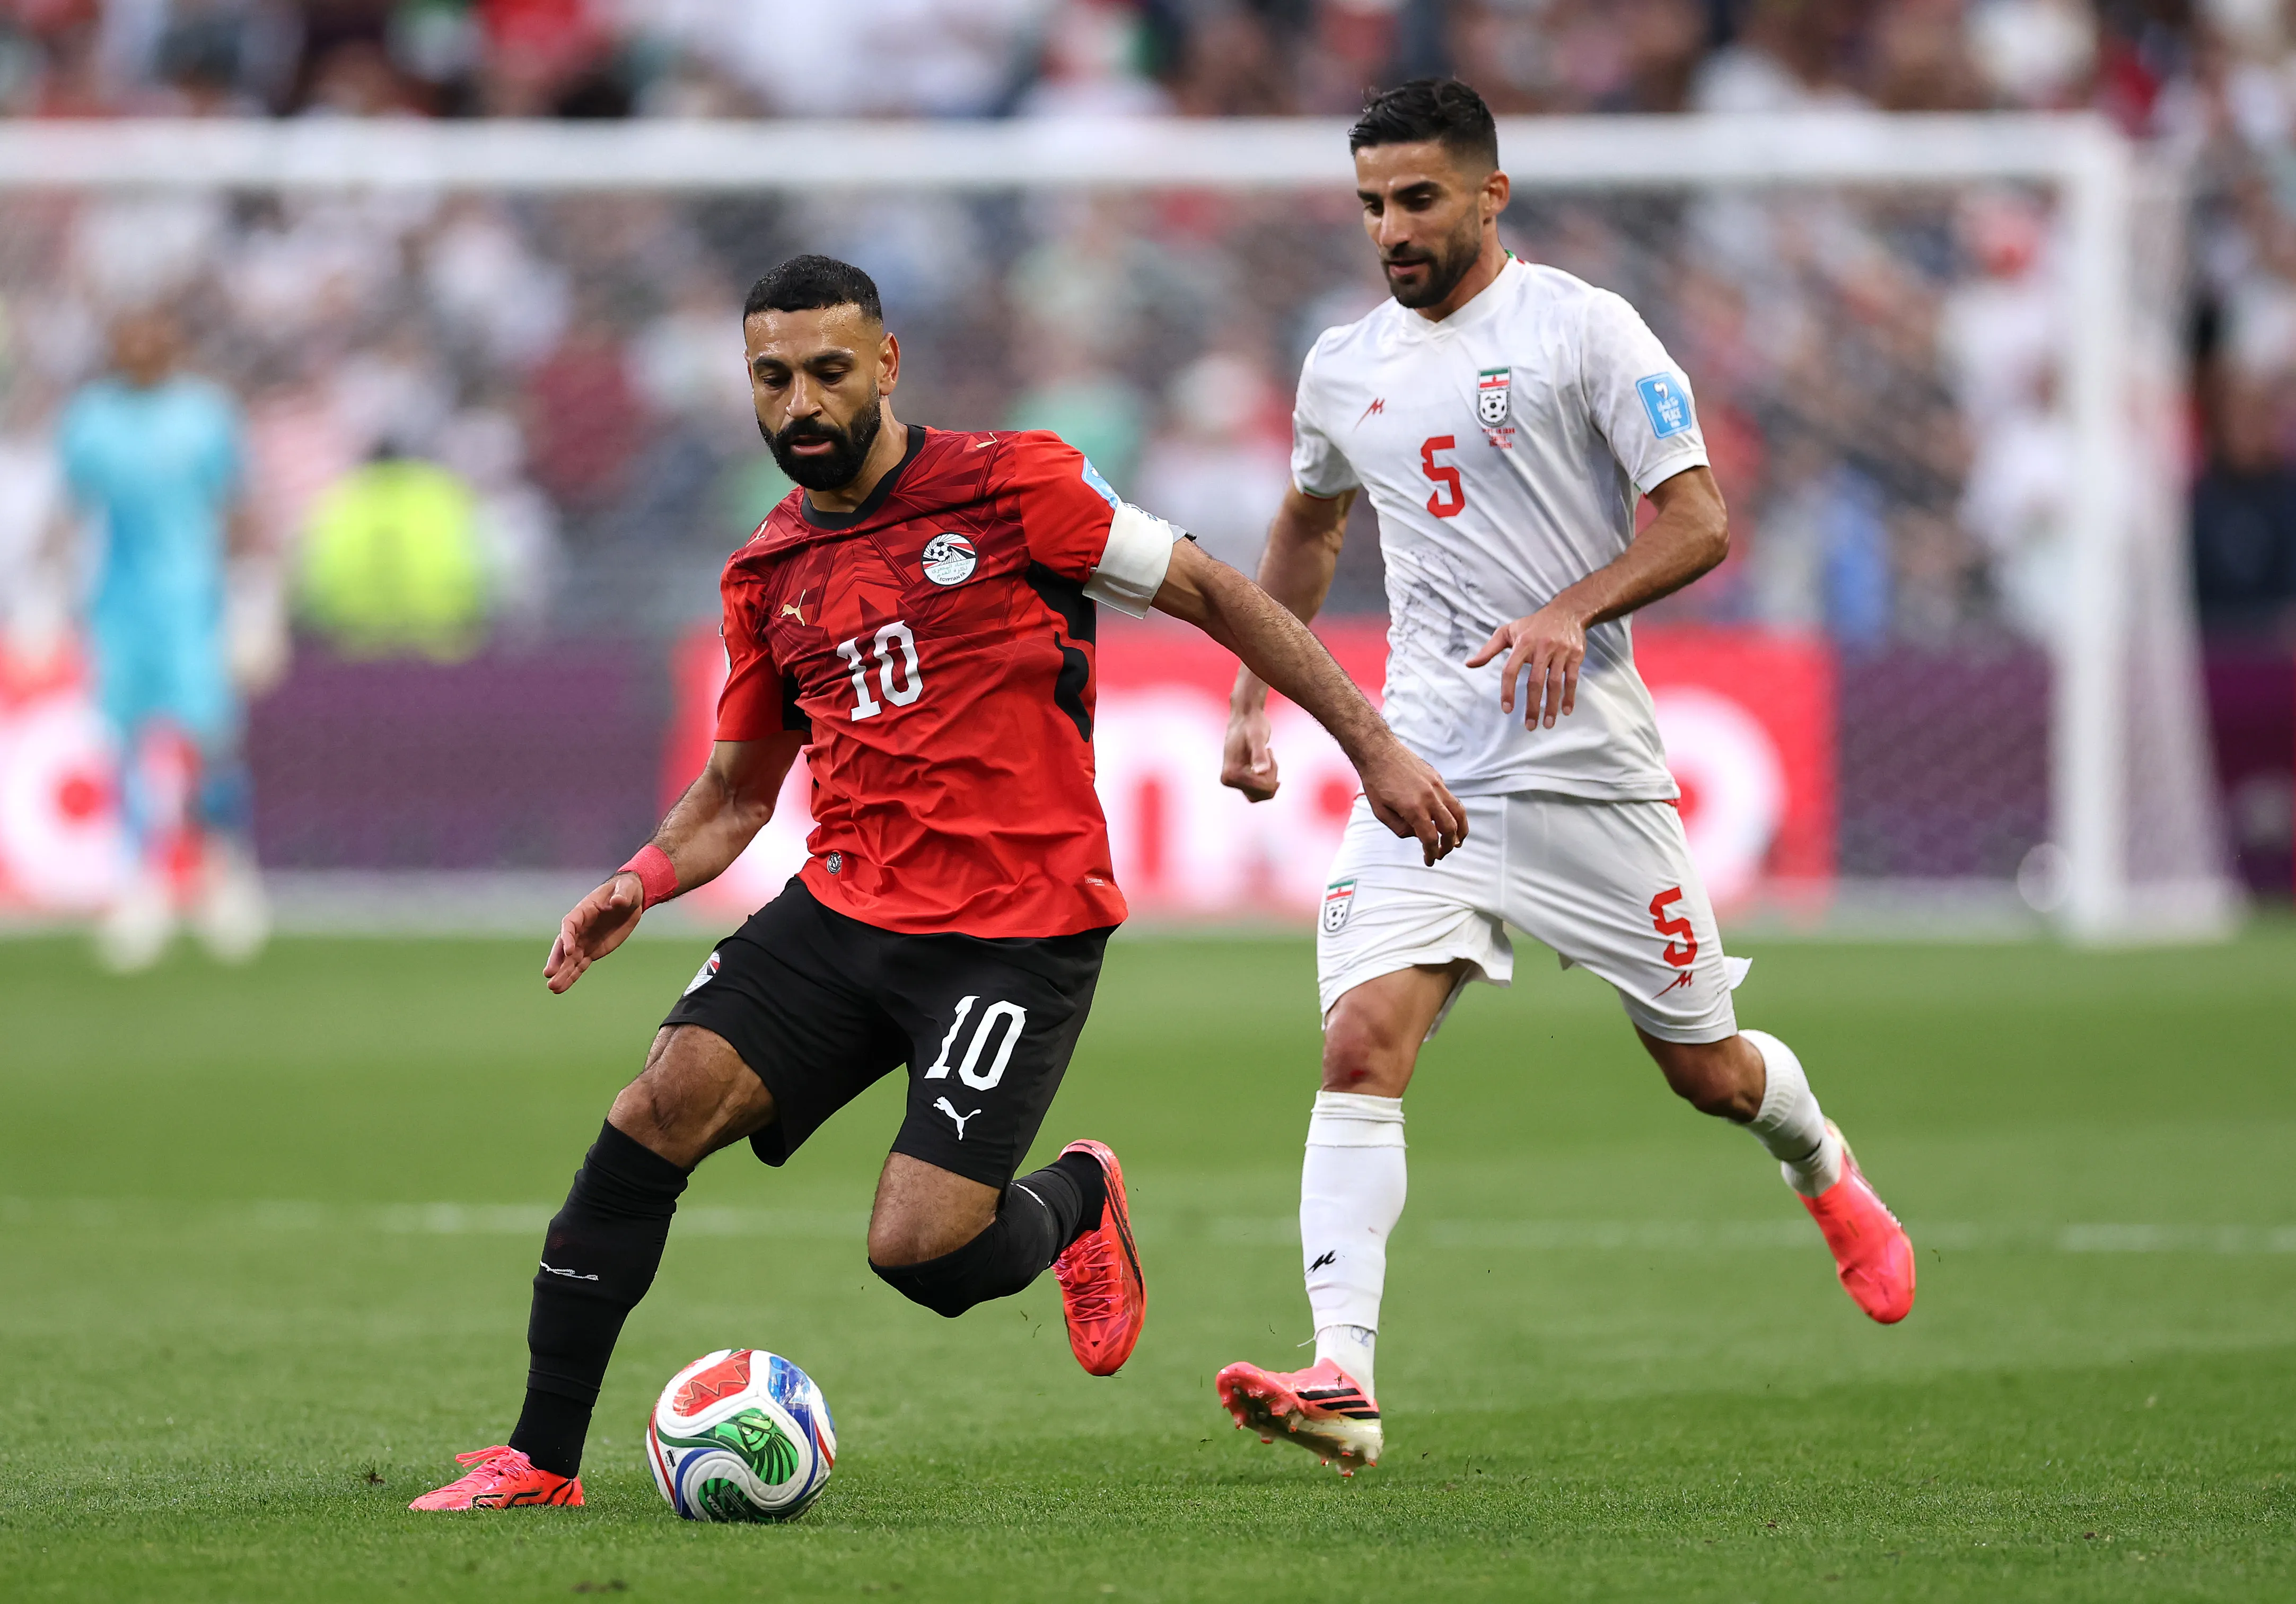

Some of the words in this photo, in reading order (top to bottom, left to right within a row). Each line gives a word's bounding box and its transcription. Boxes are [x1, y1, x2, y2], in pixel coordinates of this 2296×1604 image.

[1420, 434, 1465, 518] 5
[836, 619, 924, 722] 10
[1649, 886, 1698, 968] 5
[924, 995, 1029, 1092] 10
